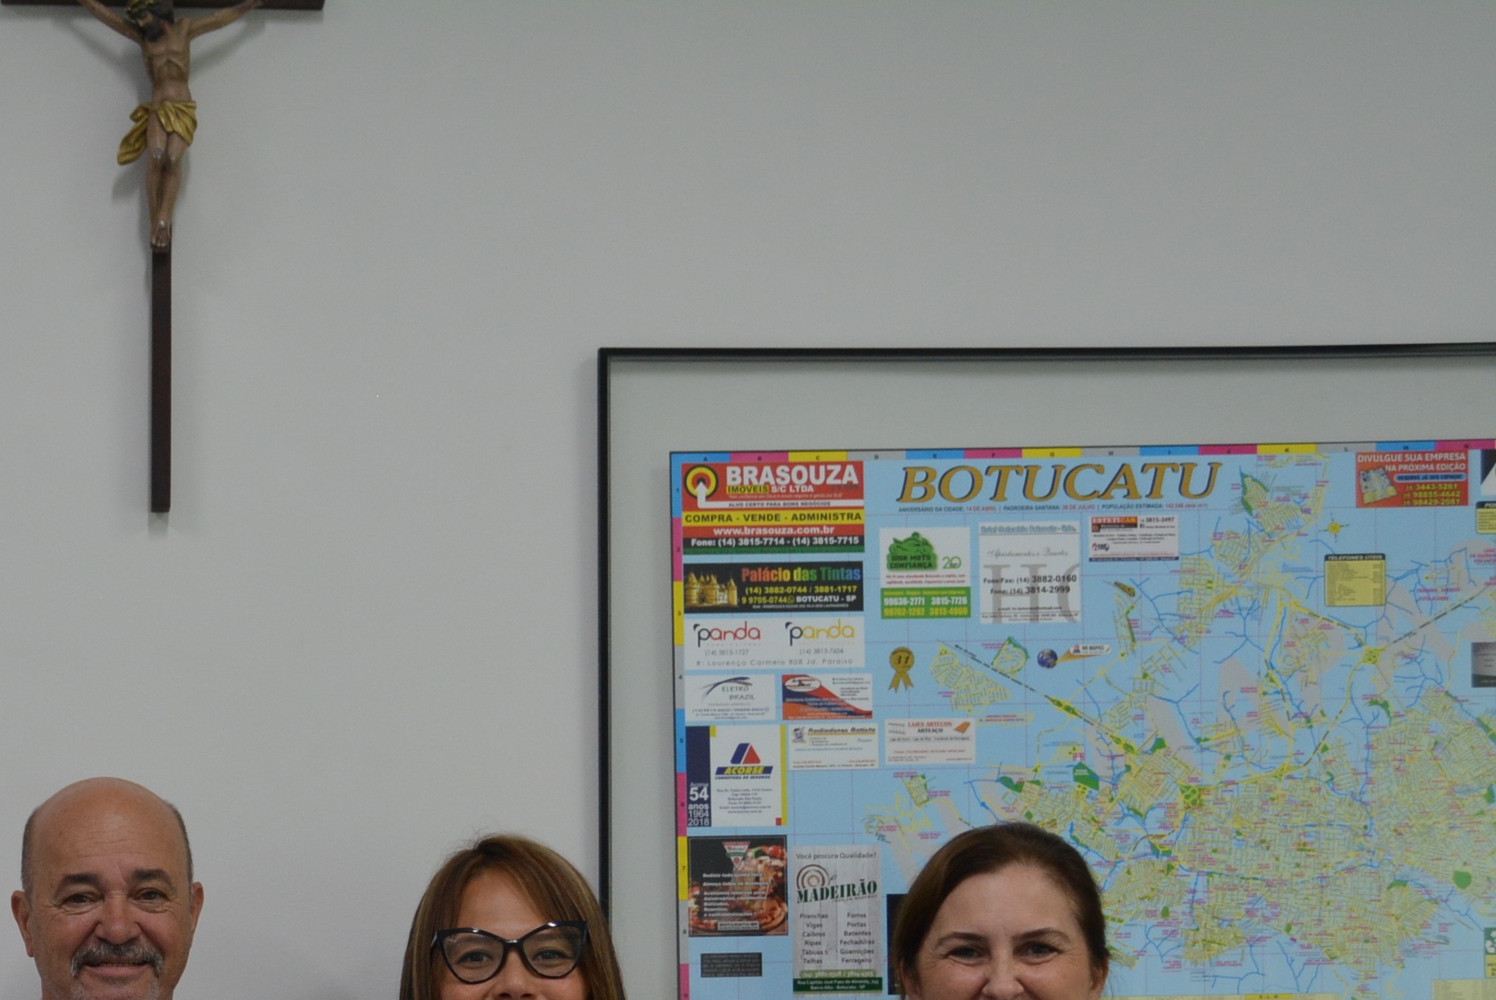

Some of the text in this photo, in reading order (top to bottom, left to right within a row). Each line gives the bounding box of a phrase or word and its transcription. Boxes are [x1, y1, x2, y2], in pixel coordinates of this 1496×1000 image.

[1357, 452, 1465, 463] DIVULGUE SUA EMPRESA
[1385, 461, 1465, 472] NA PRÓXIMA EDIÇÃO
[726, 465, 859, 486] BRASOUZA
[897, 463, 1223, 503] BOTUCATU
[789, 485, 815, 493] LTDA
[685, 512, 862, 523] COMPRA VENDE ADMINISTRA
[713, 526, 835, 536] www.brasouza.com.br
[691, 537, 859, 548] Fone: (14) 3815-7714 (14) 3815-7715
[742, 567, 861, 582] Palácio das Tintas
[1031, 575, 1077, 583] 3882-0160
[745, 586, 762, 595] (14)
[1025, 585, 1070, 594] 3814-2999
[796, 595, 839, 603] BOTUCATU
[694, 621, 761, 648] panda
[785, 619, 855, 646] panda
[724, 766, 765, 775] ACORSE
[689, 786, 709, 801] 54
[688, 810, 709, 818] 1964
[687, 817, 710, 826] 2018
[814, 853, 838, 861] procura
[840, 852, 877, 860] Qualidade?
[797, 879, 878, 904] MADEIRÃO
